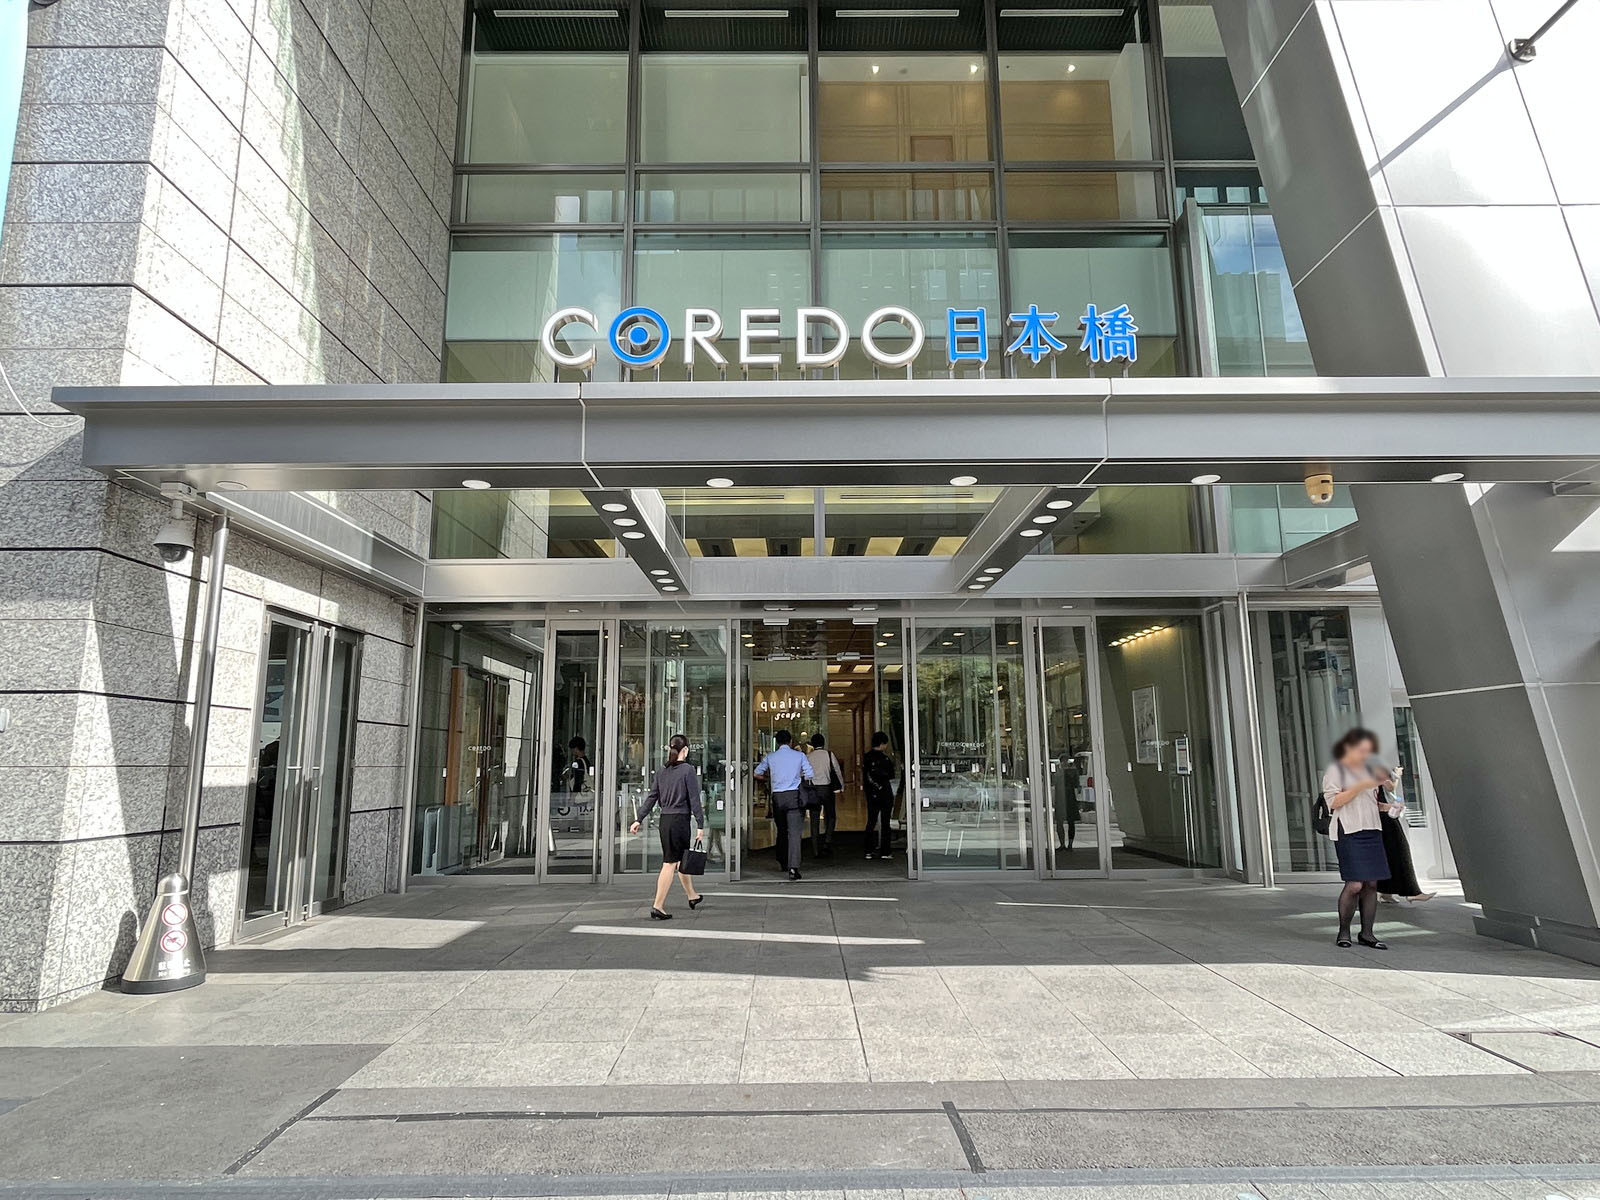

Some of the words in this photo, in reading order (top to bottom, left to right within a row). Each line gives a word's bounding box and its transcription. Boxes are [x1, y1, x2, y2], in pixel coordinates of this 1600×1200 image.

[541, 305, 926, 369] COREDO
[944, 303, 1139, 365] 日本橋
[760, 697, 815, 712] qualité
